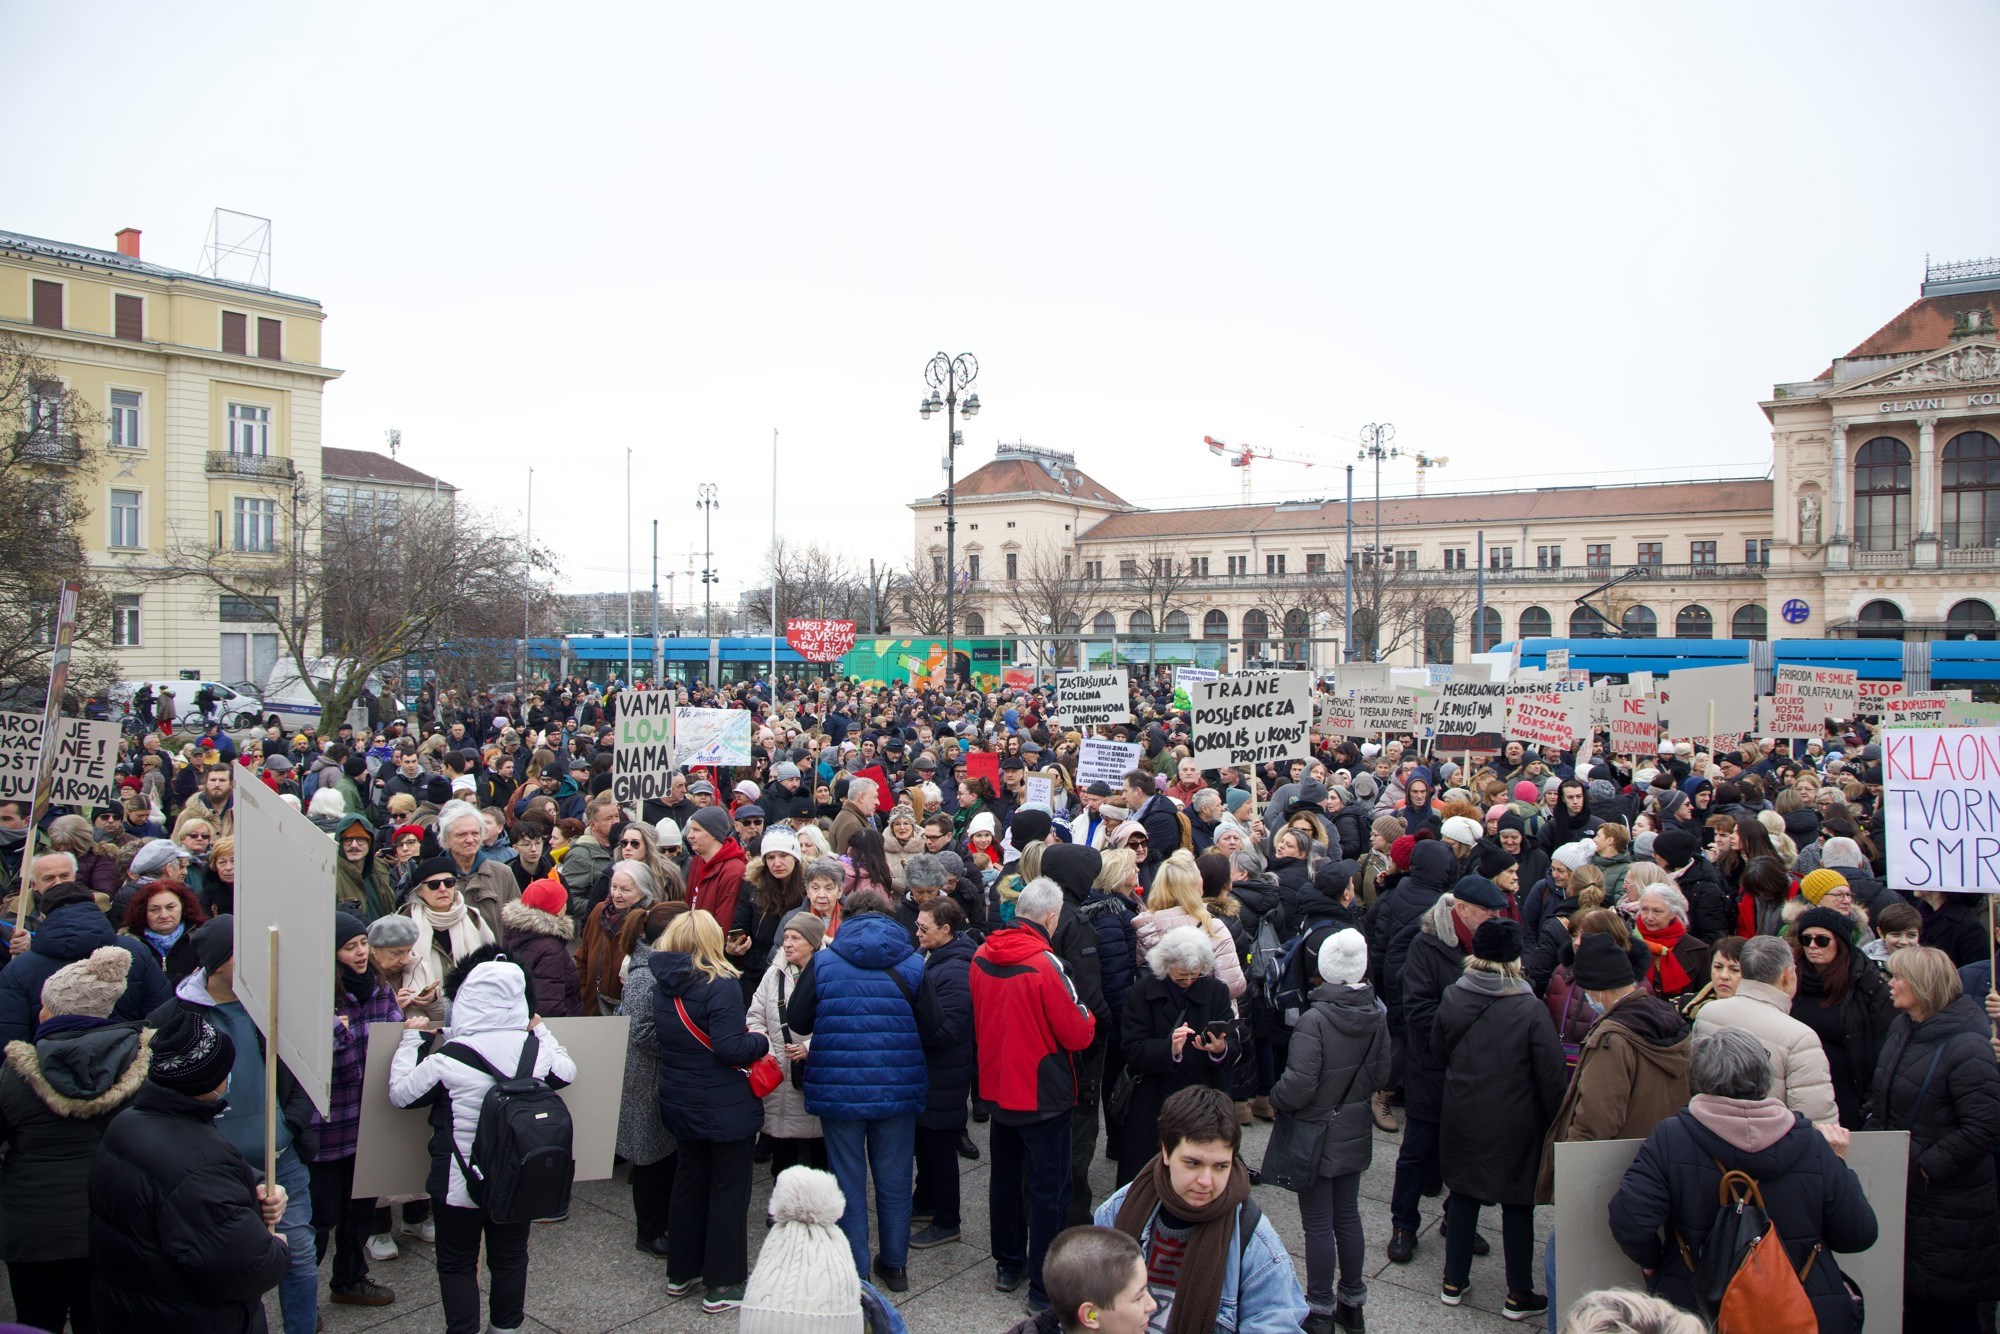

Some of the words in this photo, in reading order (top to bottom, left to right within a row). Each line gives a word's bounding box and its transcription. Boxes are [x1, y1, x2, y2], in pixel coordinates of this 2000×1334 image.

[1880, 398, 1945, 413] GLAVNI
[1060, 674, 1118, 689] ZASTRAŠUJUĆA
[1780, 669, 1812, 681] PRIRODA
[1816, 672, 1826, 683] NE
[1829, 673, 1854, 685] SMIJE
[1203, 678, 1280, 699] TRAJNE
[1443, 683, 1505, 697] MEGAKLAONICA
[1555, 680, 1584, 692] ŽELE
[1777, 683, 1793, 694] BITI
[1858, 684, 1902, 696] STOP
[1060, 690, 1101, 701] KOLIČINA
[1327, 698, 1355, 708] HRVAT
[1360, 696, 1394, 704] HRVATSKOJ
[1397, 696, 1410, 704] NE
[1772, 697, 1804, 705] KOLIKO
[620, 693, 670, 716] VAMA
[1274, 698, 1295, 716] ZA
[1359, 707, 1389, 717] TREBAJU
[1392, 709, 1413, 717] FARME
[1440, 702, 1450, 716] JE
[1624, 699, 1646, 715] NE
[1074, 714, 1110, 724] DNEVNO
[1327, 717, 1355, 729] PROT
[1775, 714, 1804, 722] JEDNA
[1894, 713, 1906, 722] DA
[1910, 711, 1941, 721] PROFIT
[66, 722, 91, 739] JE
[624, 718, 669, 744] LOJ,
[1370, 720, 1408, 729] KLAONICE
[1438, 720, 1476, 735] ZDRAVOJ
[1612, 720, 1656, 737] OTROVNIM
[1770, 720, 1824, 736] ŽUPANIJA?
[1194, 726, 1250, 752] OKOLIŠ
[1255, 731, 1266, 744] U
[1267, 720, 1308, 744] KORIST
[616, 745, 669, 774] NAMA
[1230, 744, 1288, 764] PROFITA
[50, 777, 110, 805] ARODA
[614, 771, 672, 801] GNOJ!
[1905, 838, 2000, 887] SMR
